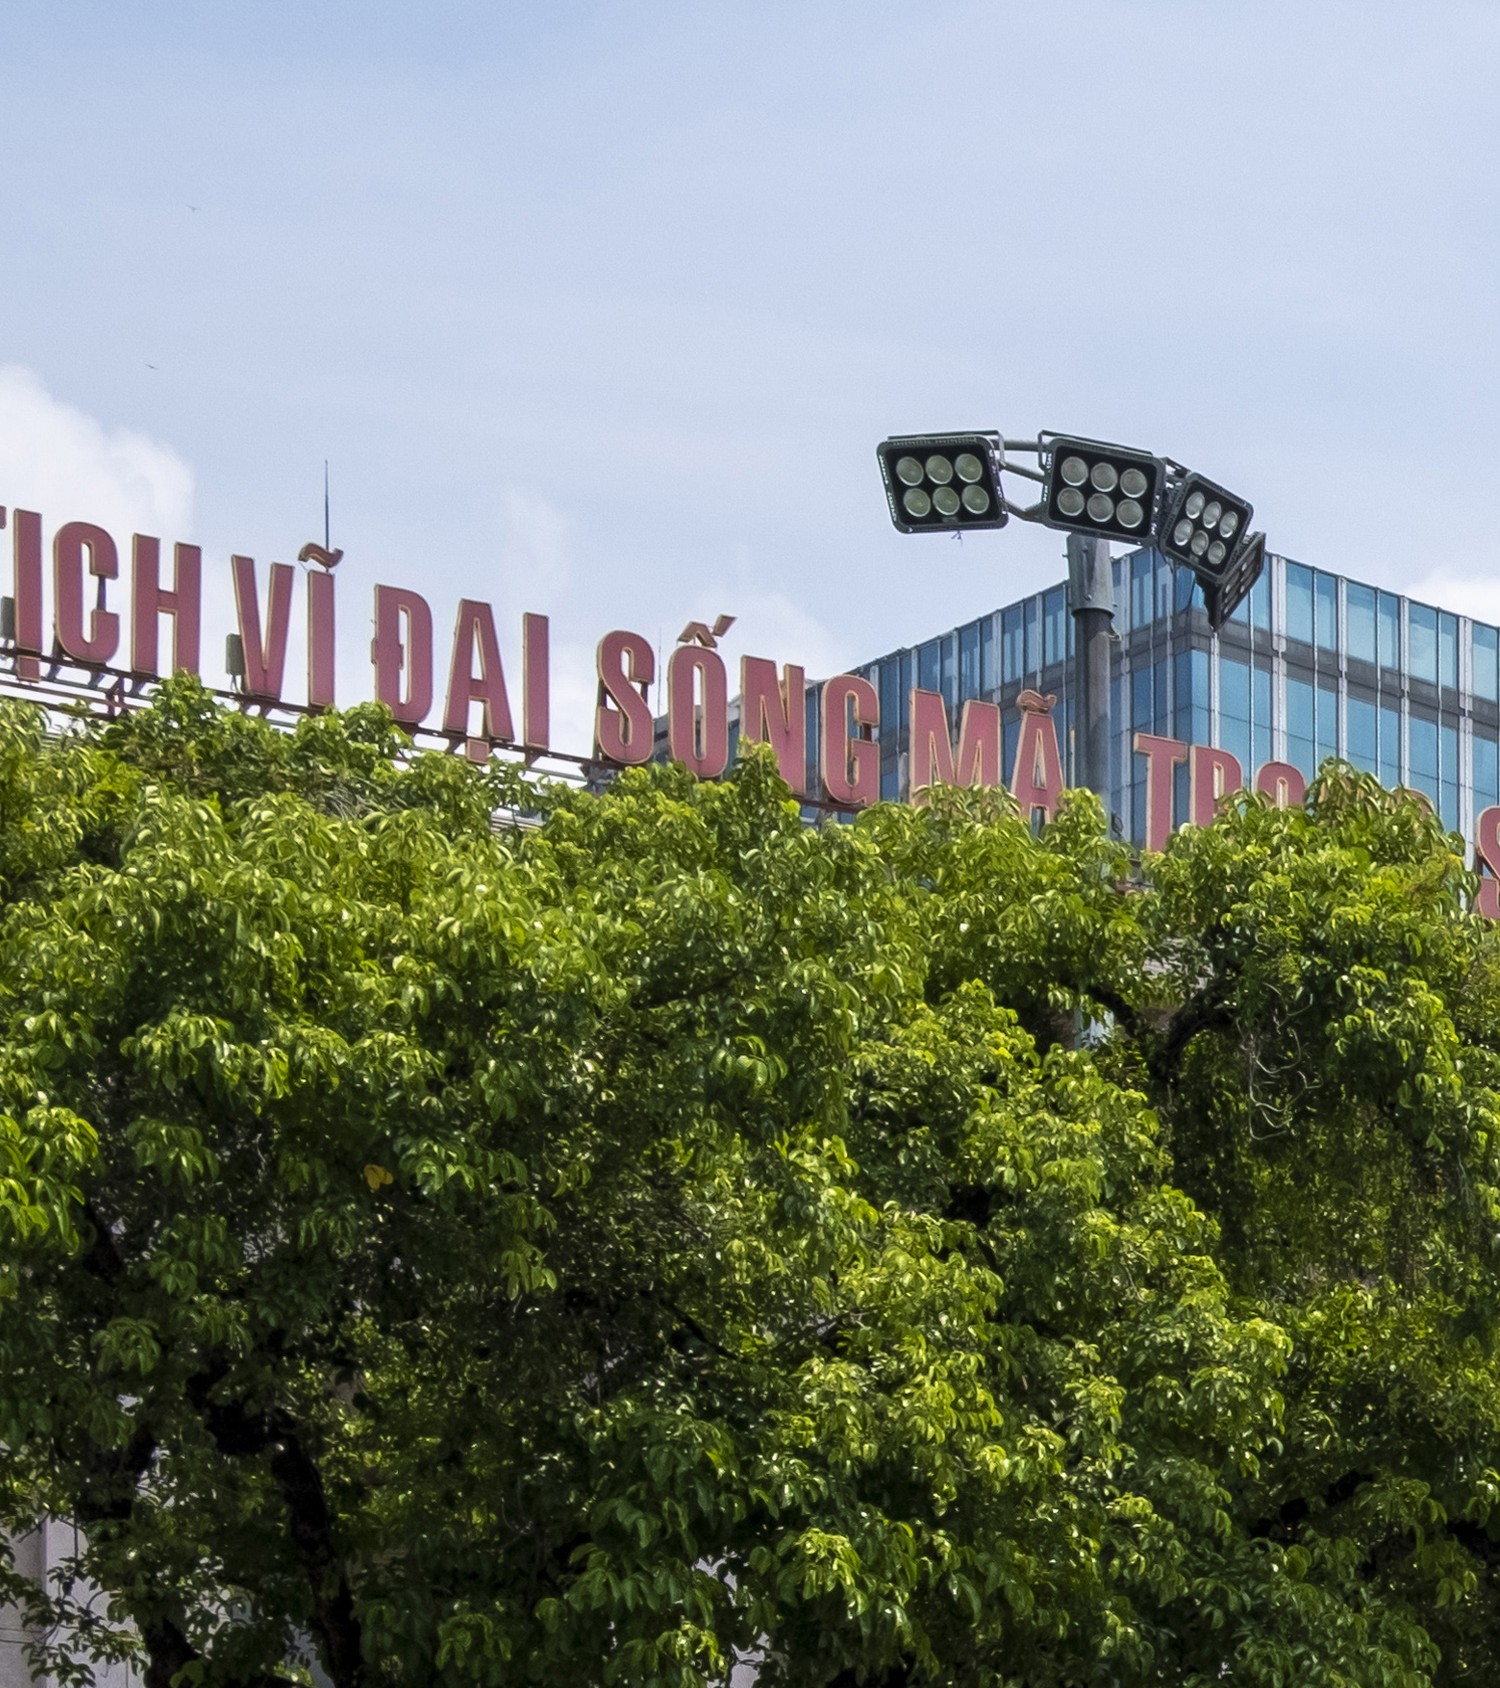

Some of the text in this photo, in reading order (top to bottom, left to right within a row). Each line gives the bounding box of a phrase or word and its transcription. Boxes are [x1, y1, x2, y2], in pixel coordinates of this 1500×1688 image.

[0, 505, 202, 683] ỊCH
[232, 542, 343, 708] VĨ
[371, 584, 549, 764] ĐẠI
[596, 615, 880, 804] SỐNG
[909, 689, 1076, 826] MÃ
